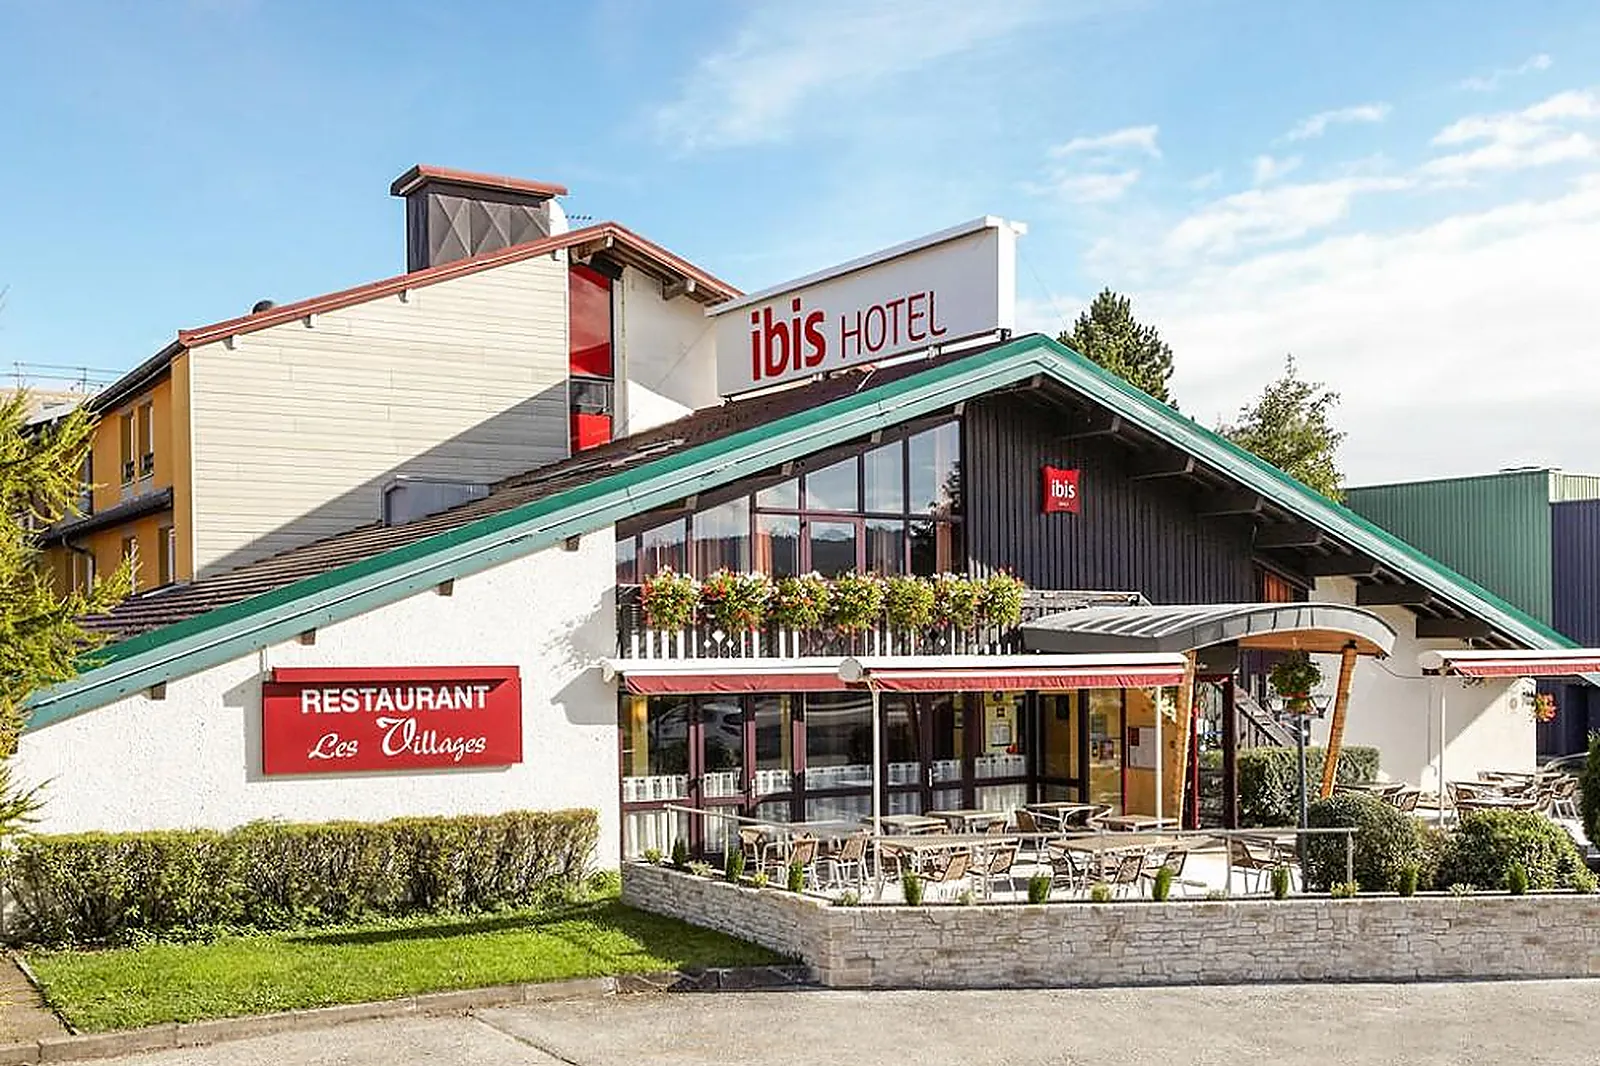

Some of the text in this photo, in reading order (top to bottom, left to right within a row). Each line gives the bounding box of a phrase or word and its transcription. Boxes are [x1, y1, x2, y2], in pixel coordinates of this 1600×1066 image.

[751, 291, 947, 381] ibis HOTEL
[1051, 478, 1076, 499] ibis
[300, 684, 490, 714] RESTAURANT
[307, 716, 486, 762] Les Villages
